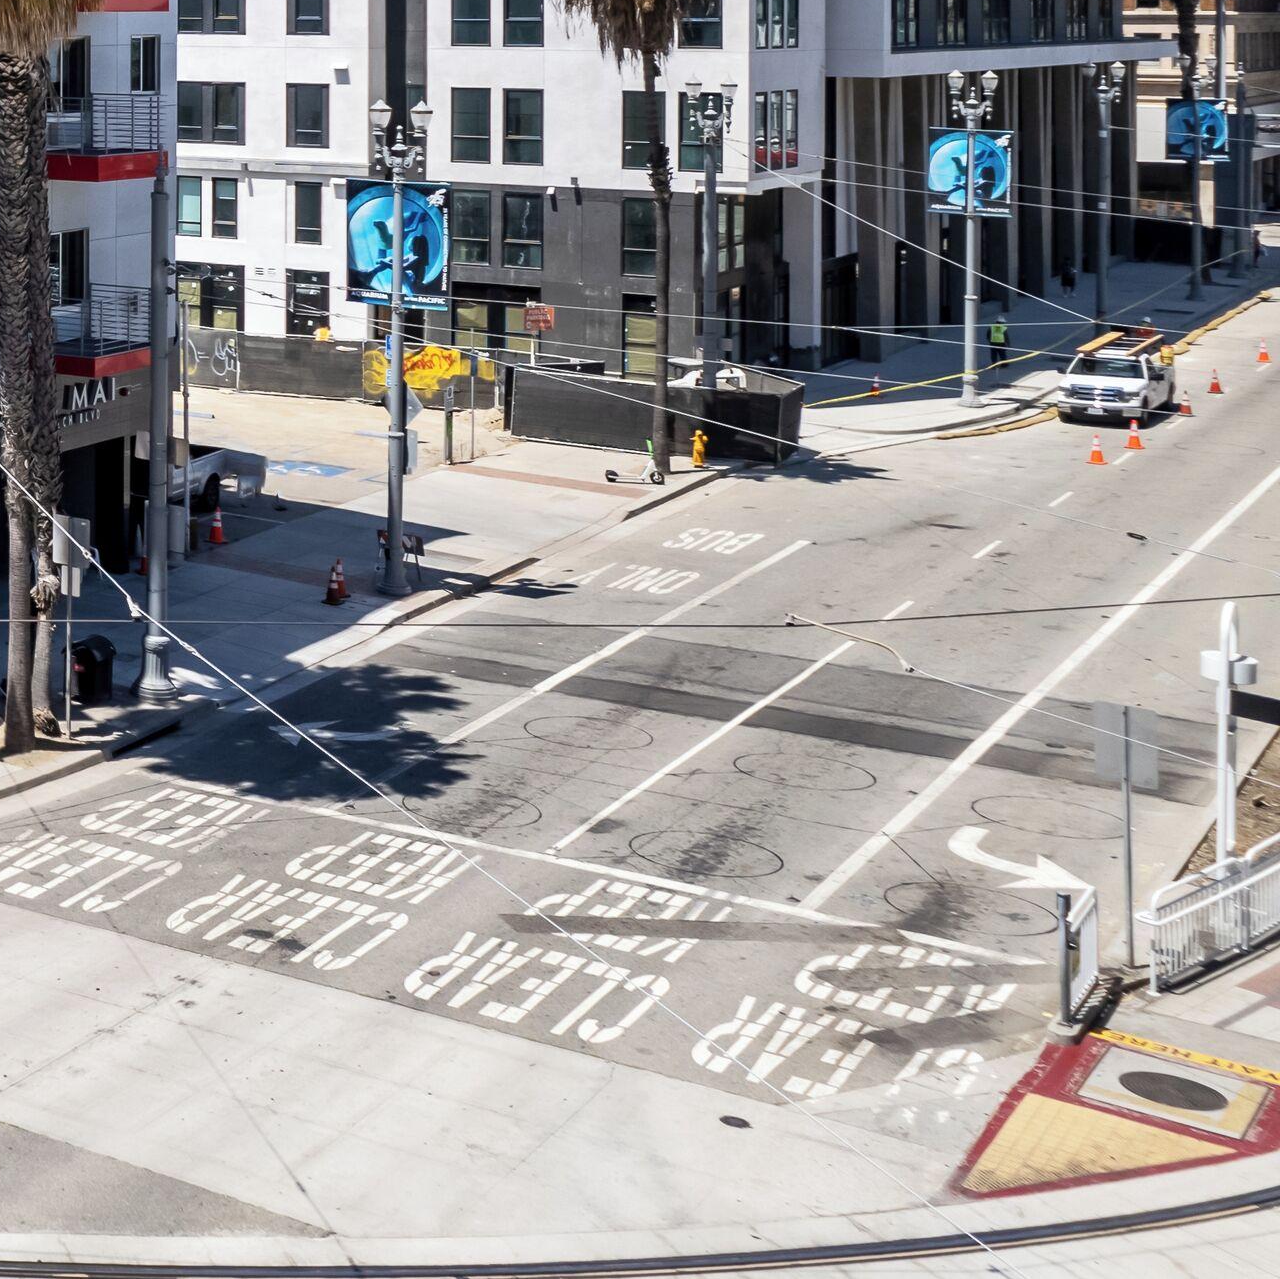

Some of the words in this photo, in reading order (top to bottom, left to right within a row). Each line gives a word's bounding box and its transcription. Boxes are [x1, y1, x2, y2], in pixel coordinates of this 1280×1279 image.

[418, 296, 446, 305] PACIFIC
[71, 377, 116, 411] MAI
[661, 527, 766, 555] BUS
[80, 787, 270, 853] KEEP
[285, 831, 482, 904] KEEP
[166, 874, 409, 971] CLEAR
[403, 932, 671, 1043] CLEAR
